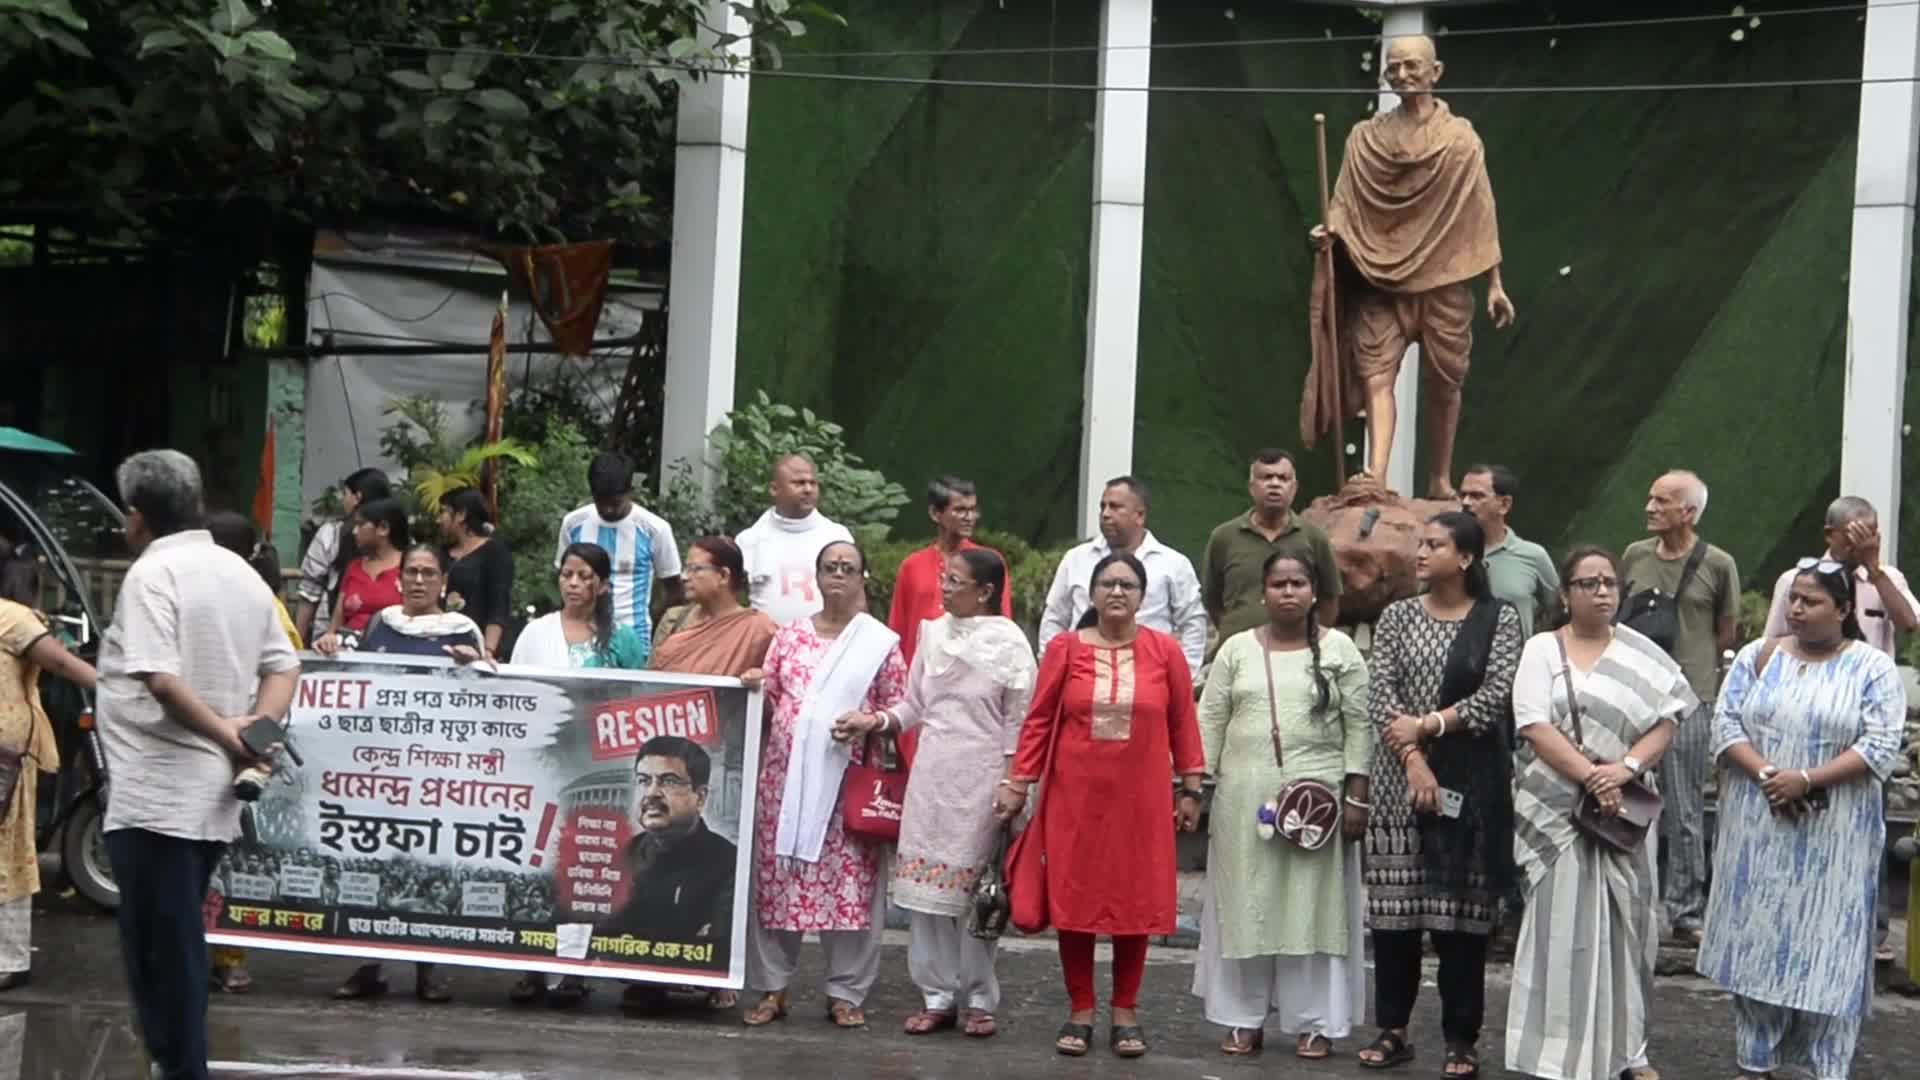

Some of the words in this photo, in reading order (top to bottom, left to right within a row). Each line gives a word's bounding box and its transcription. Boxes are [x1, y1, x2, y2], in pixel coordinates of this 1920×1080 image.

[298, 679, 372, 710] NEET
[376, 689, 407, 708] প্রশ্ন
[413, 690, 443, 708] পত্র
[448, 688, 487, 709] ফাঁস
[318, 716, 331, 730] ও
[338, 714, 374, 733] ছাত্র
[379, 712, 433, 735] ছাত্রীর
[440, 719, 476, 743] মৃত্যু
[595, 698, 710, 749] RESIGN
[407, 743, 461, 769] শিক্ষা
[468, 749, 506, 776] মন্ত্রী
[321, 764, 413, 807] ধর্মেন্দ্র
[420, 776, 534, 812] প্রধানের
[318, 800, 443, 855] ইস্তফা
[591, 933, 650, 956] নাগরিক
